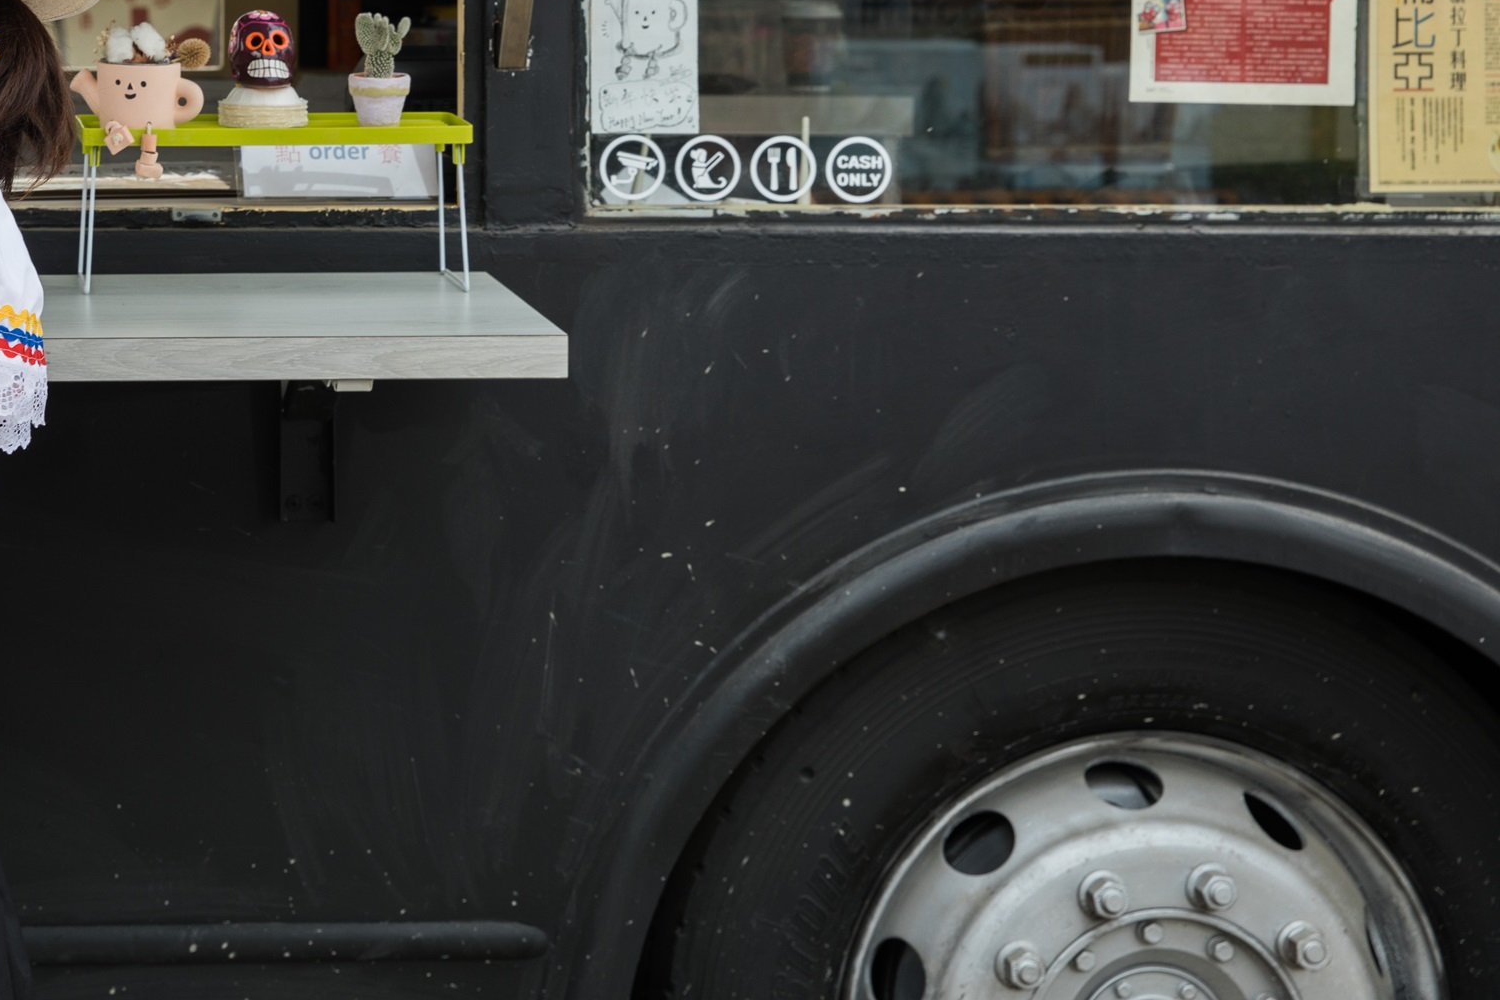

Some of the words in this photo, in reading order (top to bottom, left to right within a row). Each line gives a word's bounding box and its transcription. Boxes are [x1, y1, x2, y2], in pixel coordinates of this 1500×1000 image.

[309, 145, 370, 160] order
[836, 155, 883, 169] CASH
[836, 172, 882, 187] ONLY
